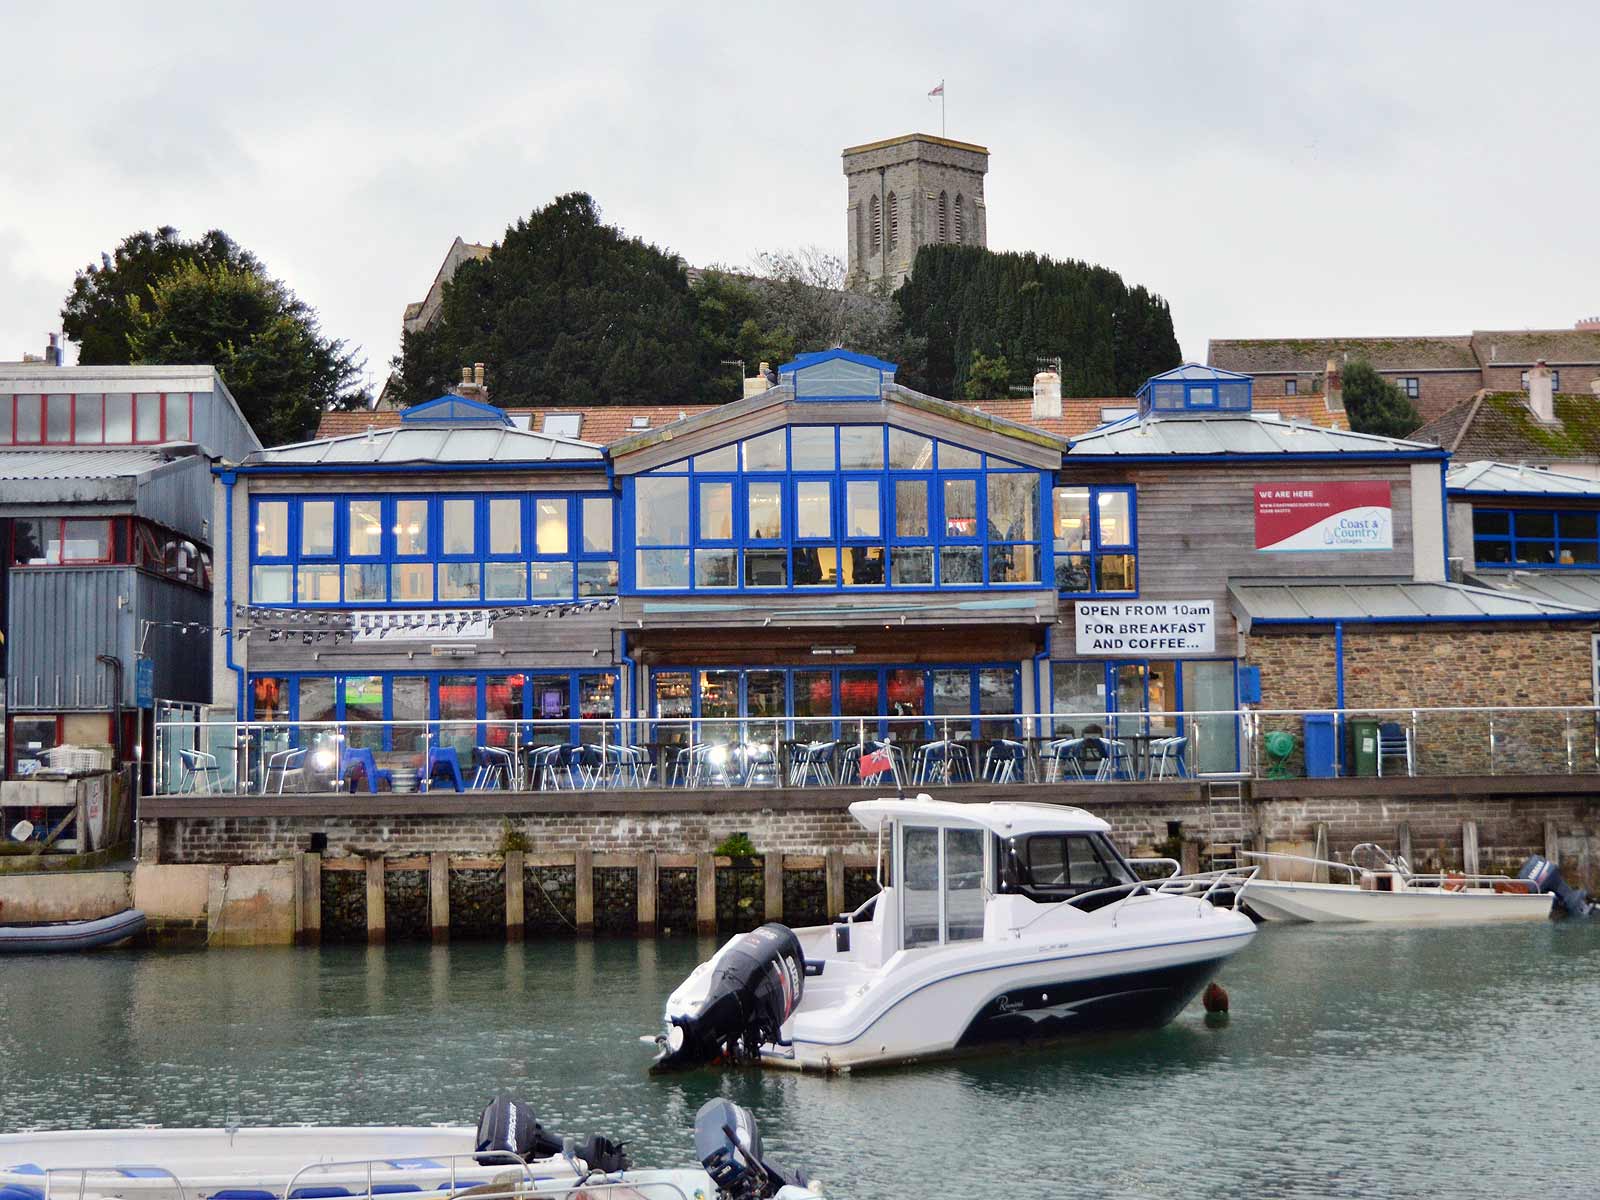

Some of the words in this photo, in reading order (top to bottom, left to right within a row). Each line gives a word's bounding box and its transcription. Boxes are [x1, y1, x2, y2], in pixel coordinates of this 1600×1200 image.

[1293, 490, 1313, 498] HERE
[1340, 518, 1368, 528] Coast
[1372, 520, 1378, 528] &
[1333, 528, 1377, 540] Country
[1080, 605, 1120, 616] OPEN
[1125, 605, 1167, 616] FROM
[1172, 605, 1210, 615] 10am
[1085, 624, 1114, 634] FOR
[1119, 623, 1206, 634] BREAKFAST
[1093, 639, 1123, 649] AND
[1128, 638, 1200, 649] COFFEE...
[507, 1102, 518, 1152] MERCURY
